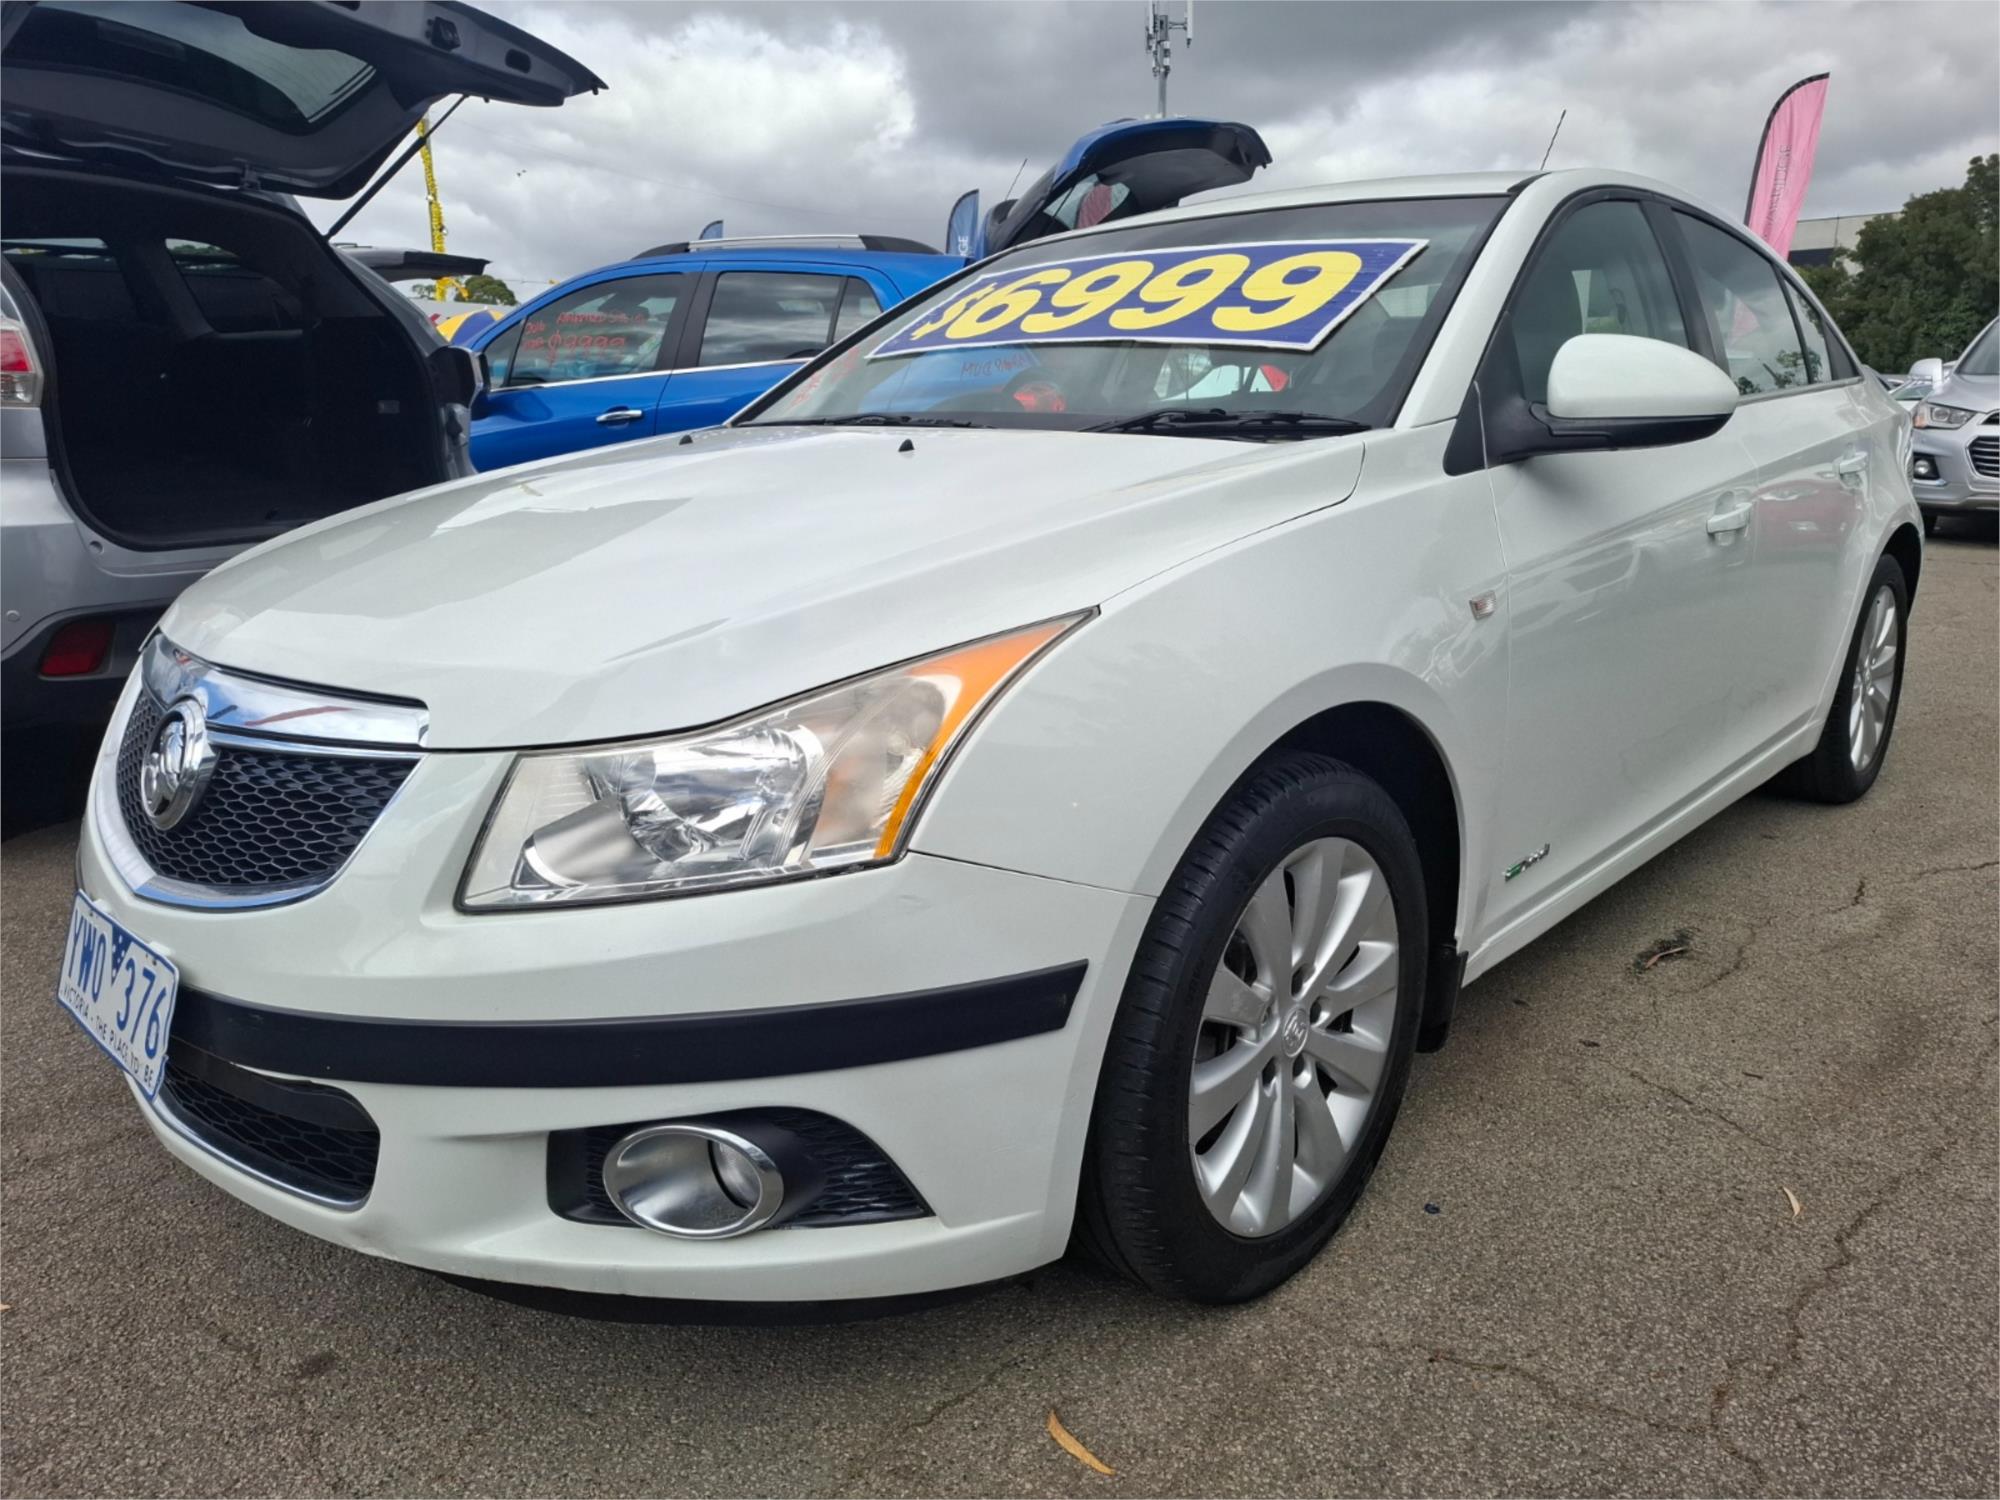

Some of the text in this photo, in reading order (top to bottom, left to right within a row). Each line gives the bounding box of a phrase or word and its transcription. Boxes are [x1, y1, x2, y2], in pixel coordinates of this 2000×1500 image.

[910, 250, 1362, 339] $6999
[96, 1014, 107, 1041] THE
[109, 1029, 129, 1062] PLACE
[130, 1051, 140, 1075] TO
[143, 1064, 154, 1088] BE
[116, 957, 167, 1060] 376
